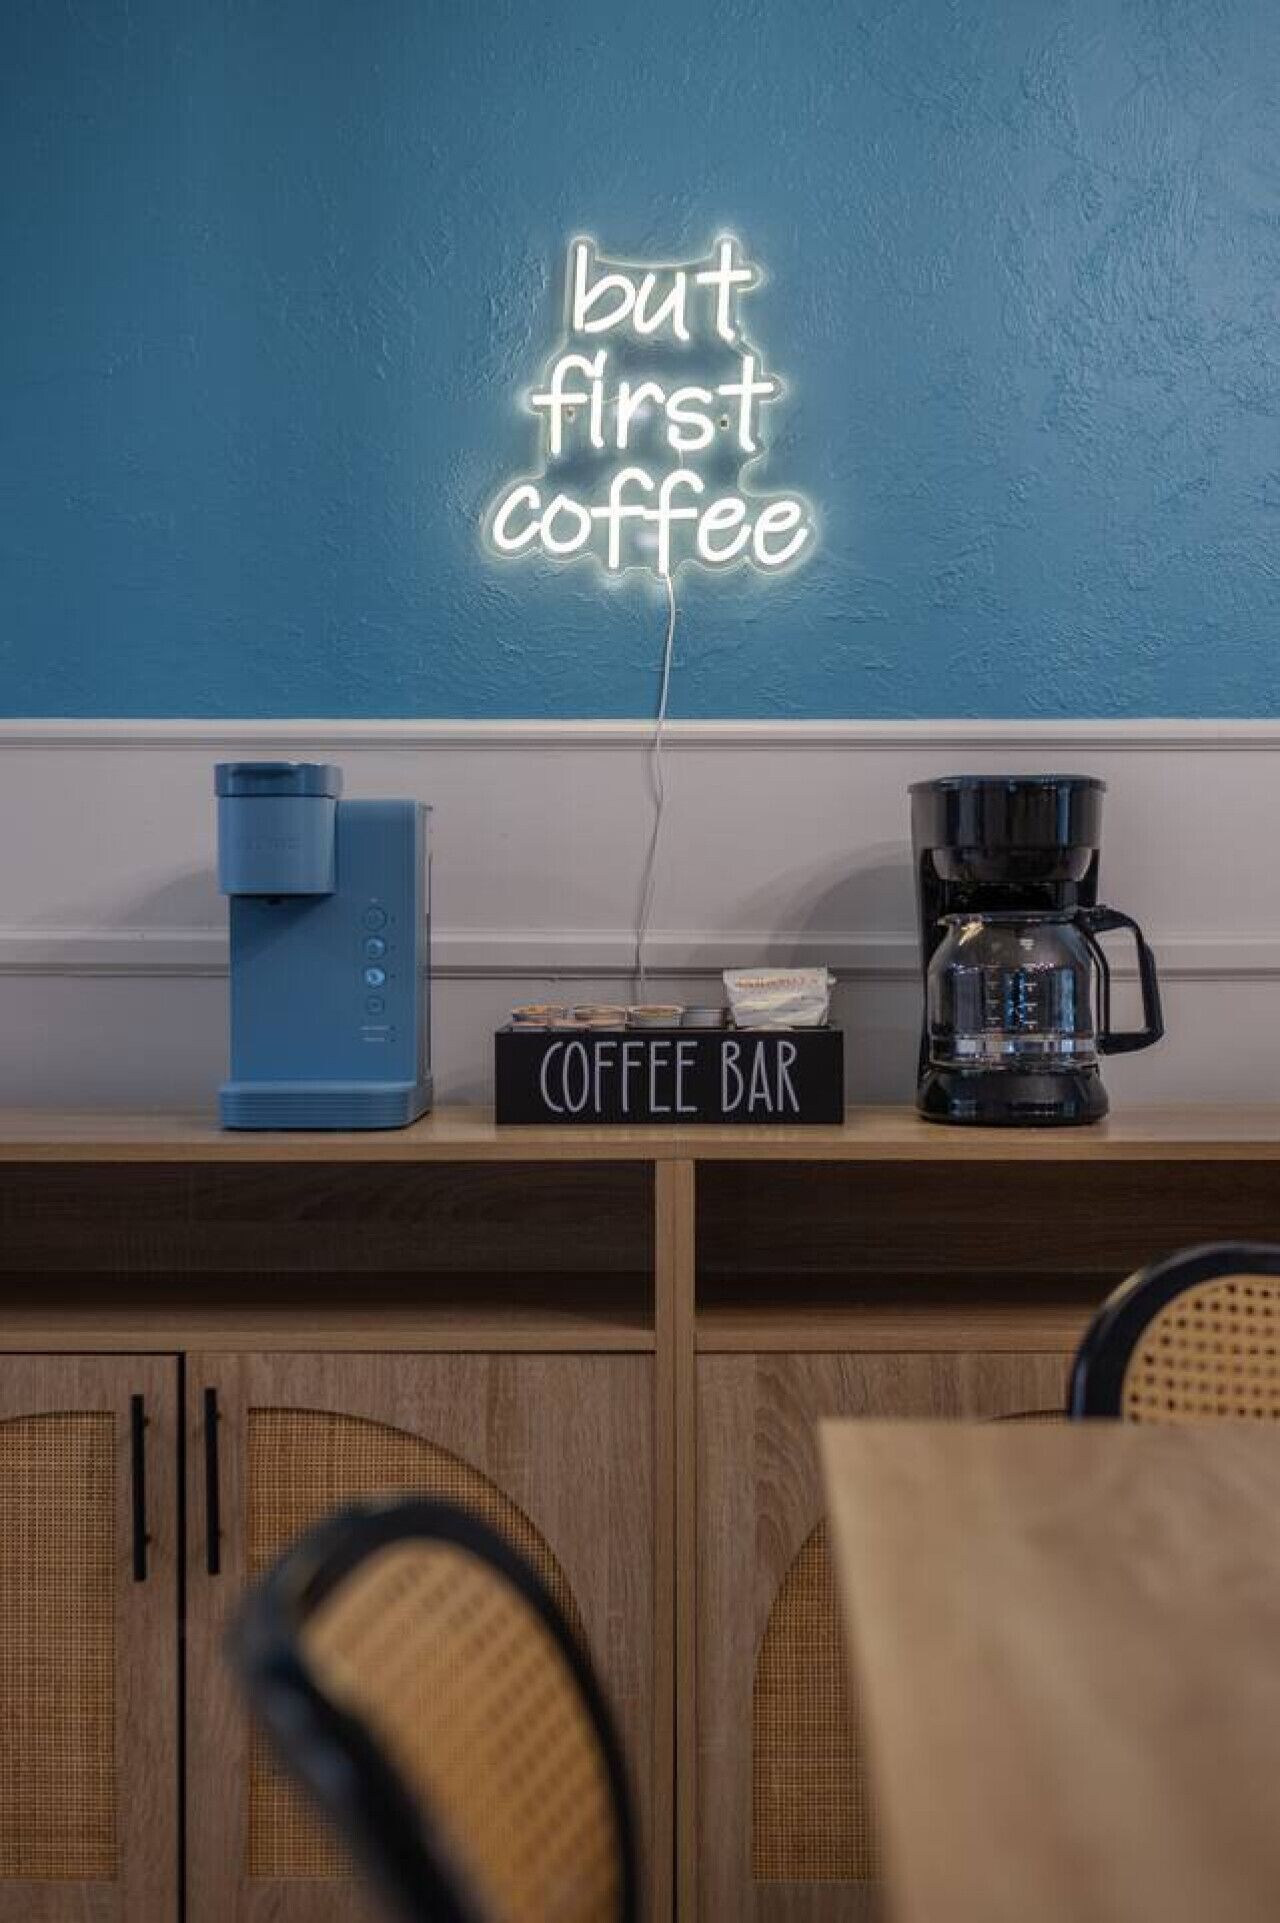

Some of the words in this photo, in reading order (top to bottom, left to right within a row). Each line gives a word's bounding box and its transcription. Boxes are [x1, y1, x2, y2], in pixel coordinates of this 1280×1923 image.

[573, 244, 751, 340] but
[532, 350, 774, 455] first
[493, 467, 808, 574] coffee
[541, 1041, 698, 1112] COFFEE
[721, 1041, 800, 1112] BAR
